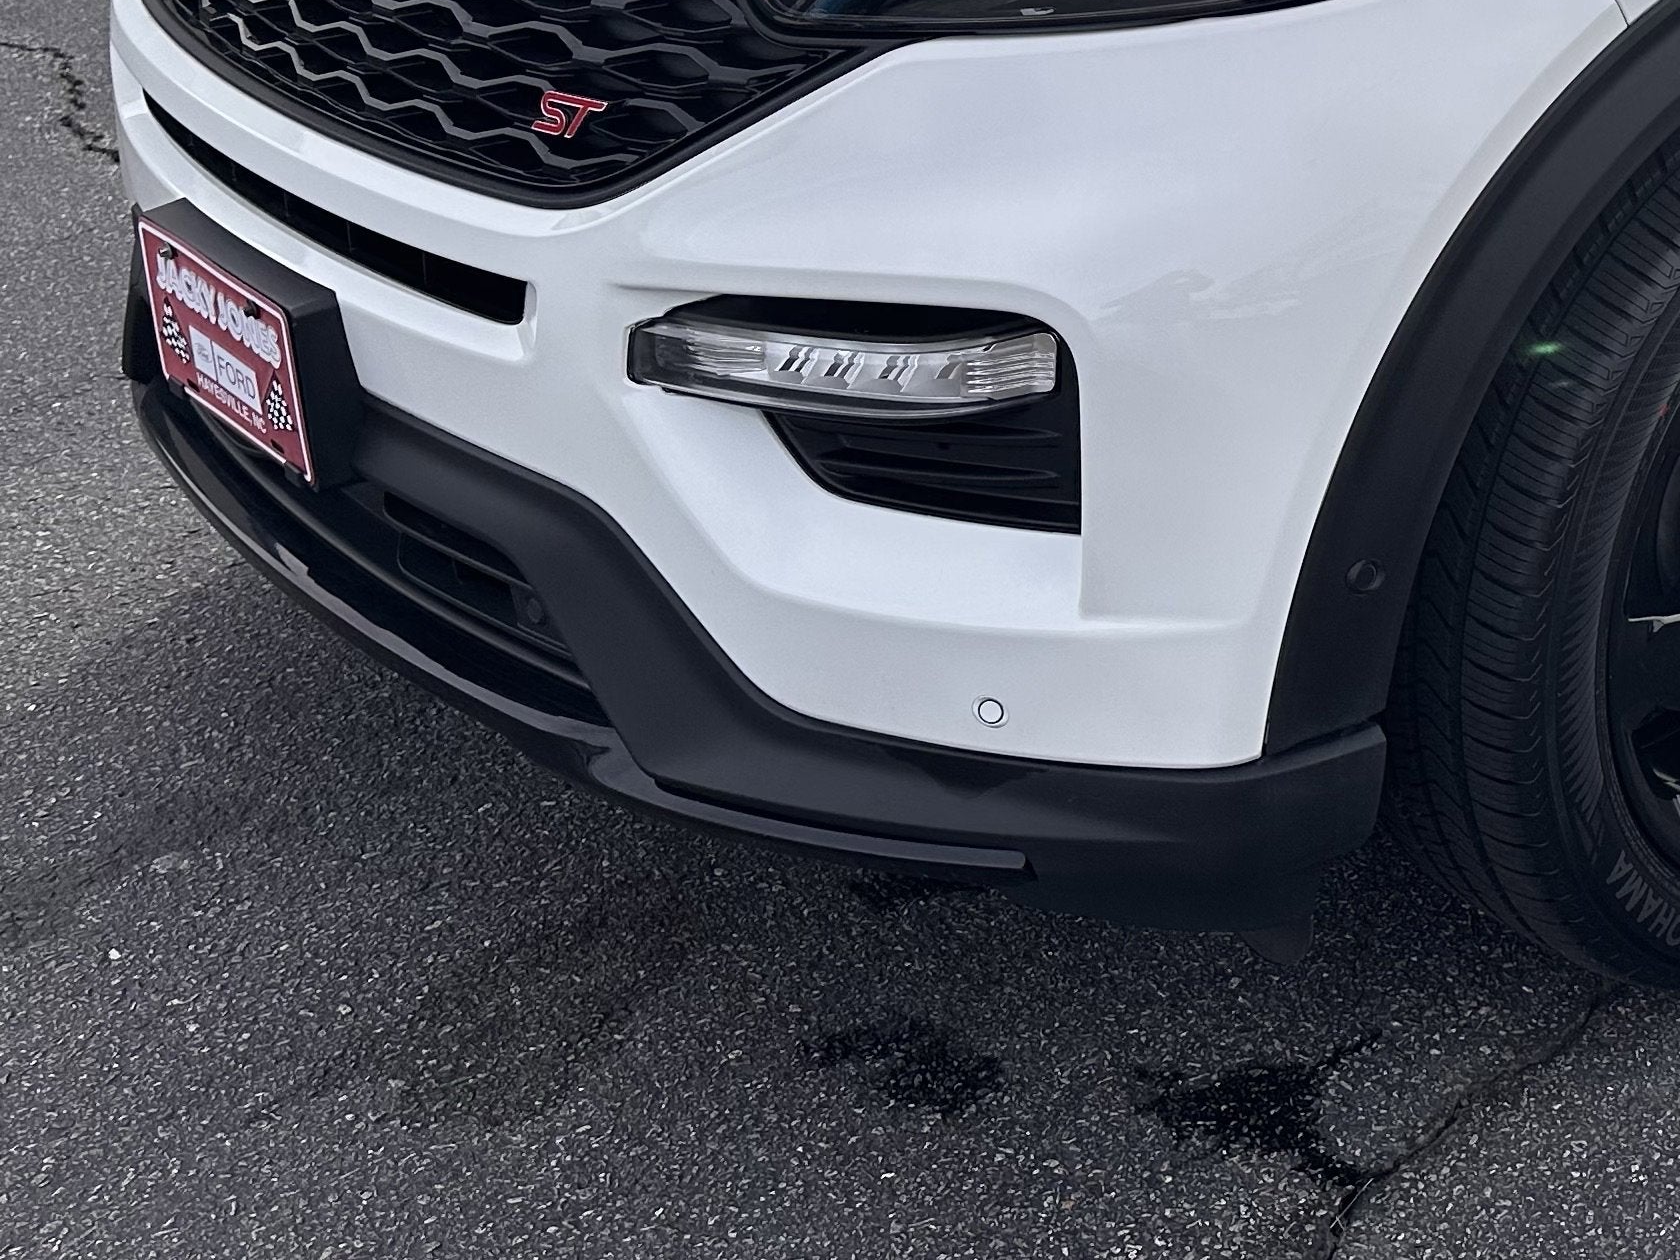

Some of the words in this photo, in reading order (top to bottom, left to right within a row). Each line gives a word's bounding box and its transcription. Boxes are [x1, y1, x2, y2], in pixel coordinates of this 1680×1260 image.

[531, 91, 608, 138] ST
[156, 253, 217, 325] JACKY
[217, 293, 282, 369] JONES
[217, 355, 257, 399] FORD
